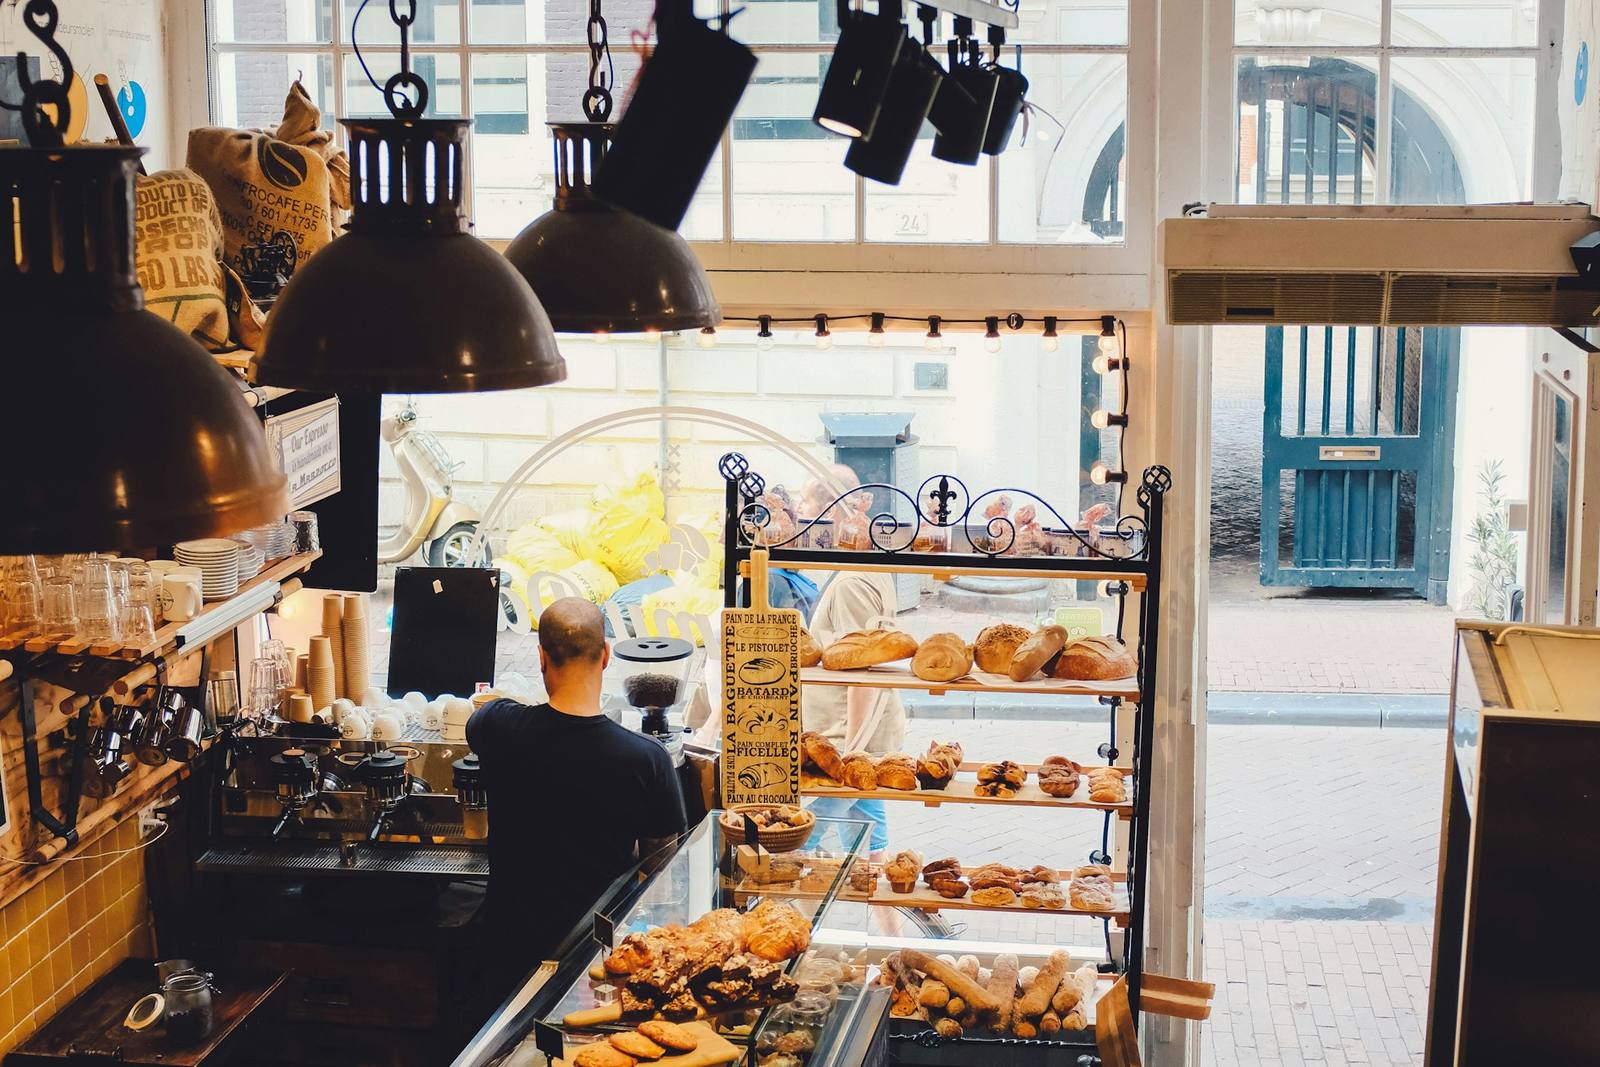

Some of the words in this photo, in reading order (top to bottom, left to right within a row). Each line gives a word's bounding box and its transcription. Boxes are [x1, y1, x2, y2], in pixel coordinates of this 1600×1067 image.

[136, 183, 187, 206] DUCTO
[261, 206, 281, 222] 601
[292, 215, 319, 232] 1735
[901, 214, 920, 232] 24
[136, 232, 209, 256] ROP
[725, 613, 743, 624] PAIN
[744, 613, 755, 624] DE
[756, 613, 766, 624] LA
[767, 614, 797, 624] FRANCE
[735, 643, 746, 652] LE
[748, 643, 790, 652] PISTOLET
[790, 625, 798, 669] BRIOCHE
[725, 625, 736, 725] BAGUETTE
[737, 687, 790, 696] BATARD
[789, 669, 799, 721] PAIN
[726, 731, 736, 754] LA
[736, 747, 790, 757] FICELLE
[789, 730, 799, 795] ROND
[727, 794, 745, 803] PAIN
[745, 794, 757, 803] AU
[757, 794, 799, 804] CHOCOLAT
